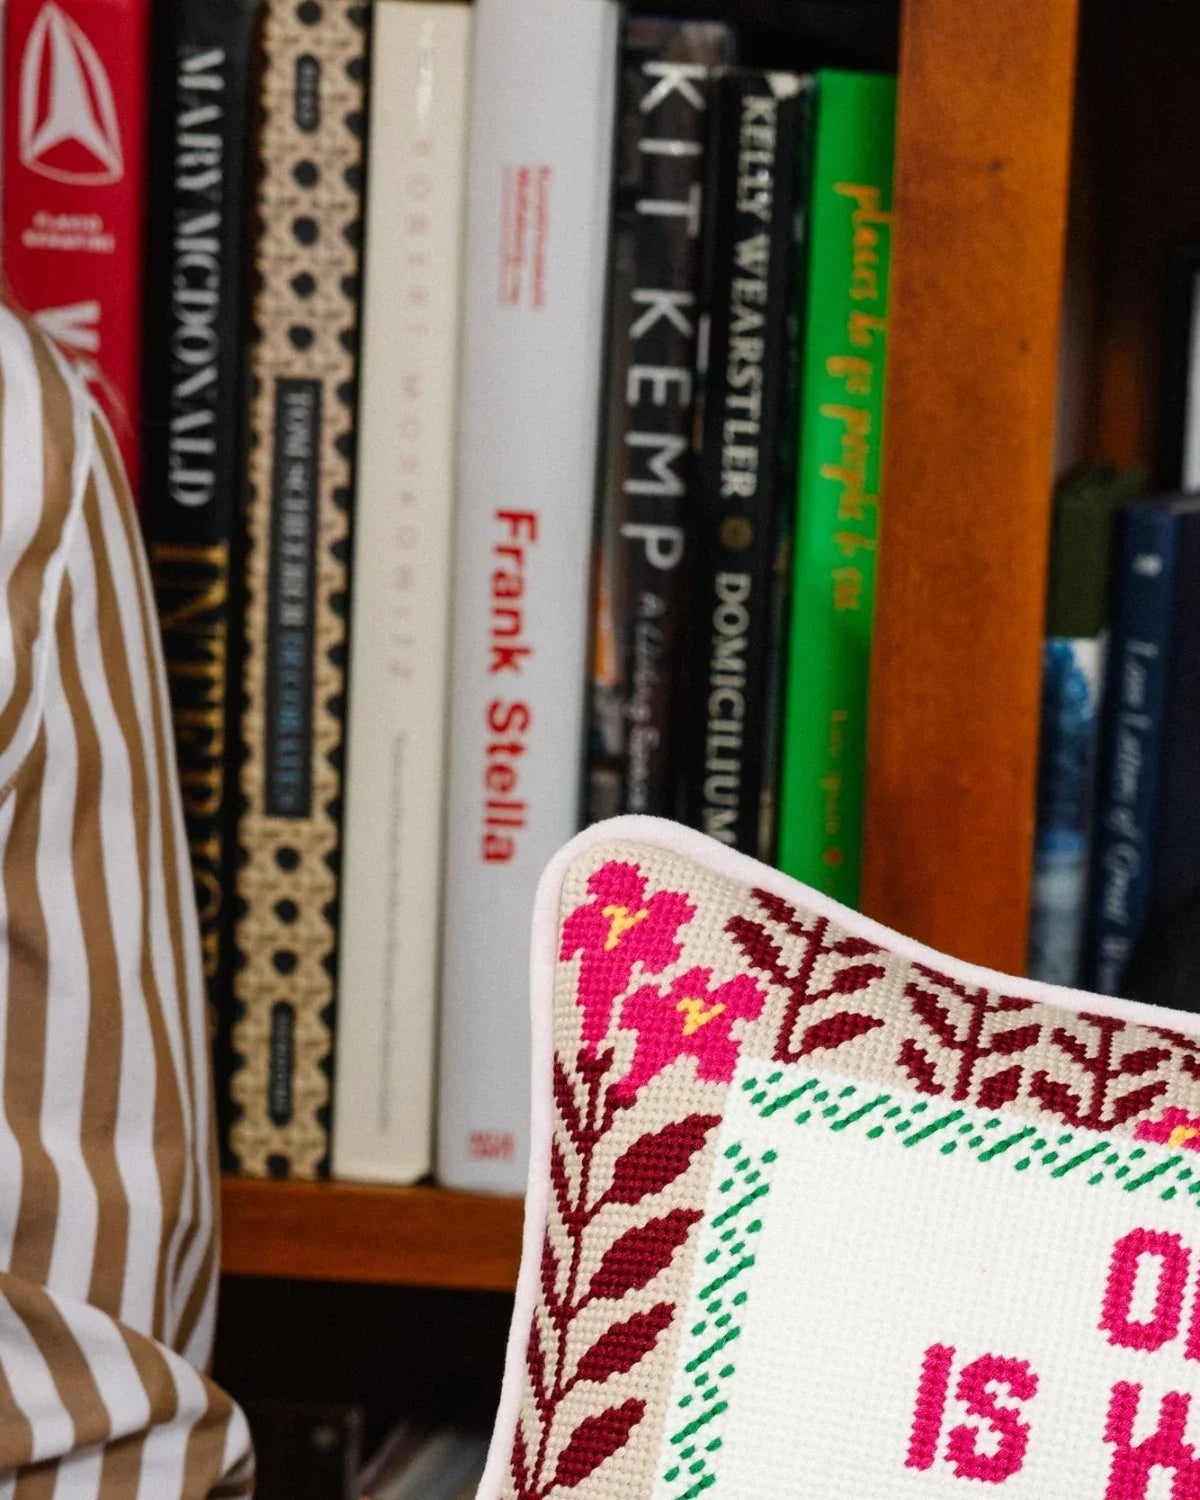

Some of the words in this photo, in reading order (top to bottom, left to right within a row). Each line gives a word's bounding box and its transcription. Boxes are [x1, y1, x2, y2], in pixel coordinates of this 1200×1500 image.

[174, 44, 226, 206] MARY
[637, 61, 708, 236] KIT
[736, 96, 778, 222] KELLY
[620, 287, 695, 571] KEMP
[719, 232, 771, 498] WEARSTLER
[488, 510, 538, 675] Frank
[480, 699, 533, 865] Stella
[702, 570, 753, 847] DOMICILIUM
[904, 1342, 1040, 1484] IS
